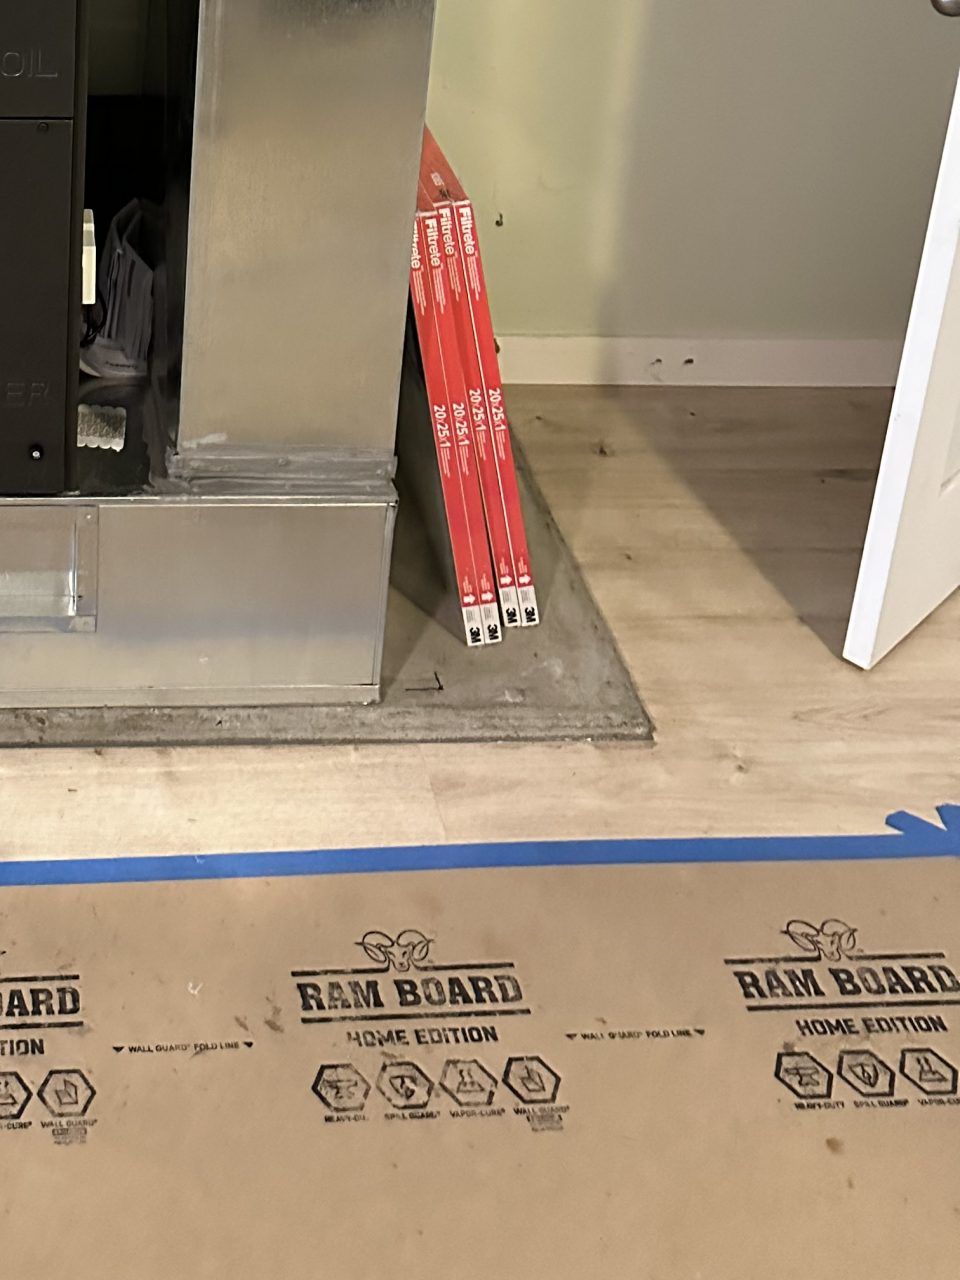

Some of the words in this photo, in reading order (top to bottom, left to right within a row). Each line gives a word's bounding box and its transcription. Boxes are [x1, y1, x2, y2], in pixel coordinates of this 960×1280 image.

[425, 218, 441, 267] Filtrete
[439, 207, 455, 255] Filtrete
[458, 207, 475, 255] Filtrete
[433, 404, 451, 448] 20x25x1
[452, 402, 470, 446] 20x25x1
[469, 387, 487, 431] 20x25x1
[488, 387, 506, 431] 20x25x1
[487, 623, 499, 641] 3M
[505, 607, 518, 624] 3M
[524, 606, 536, 623] 3M
[469, 626, 482, 644] 3M
[296, 980, 384, 1011] RAM
[393, 974, 523, 1007] BOARD
[733, 968, 825, 999] RAM
[828, 964, 960, 996] BOARD
[346, 1029, 410, 1048] HOME
[414, 1025, 499, 1045] EDITION
[645, 1029, 670, 1038] FOLD
[671, 1028, 692, 1037] LINE
[795, 1019, 860, 1036] HOME
[861, 1015, 948, 1034] EDITION
[128, 1045, 154, 1053] WALL
[193, 1041, 218, 1051] FOLD
[219, 1040, 240, 1049] LINE
